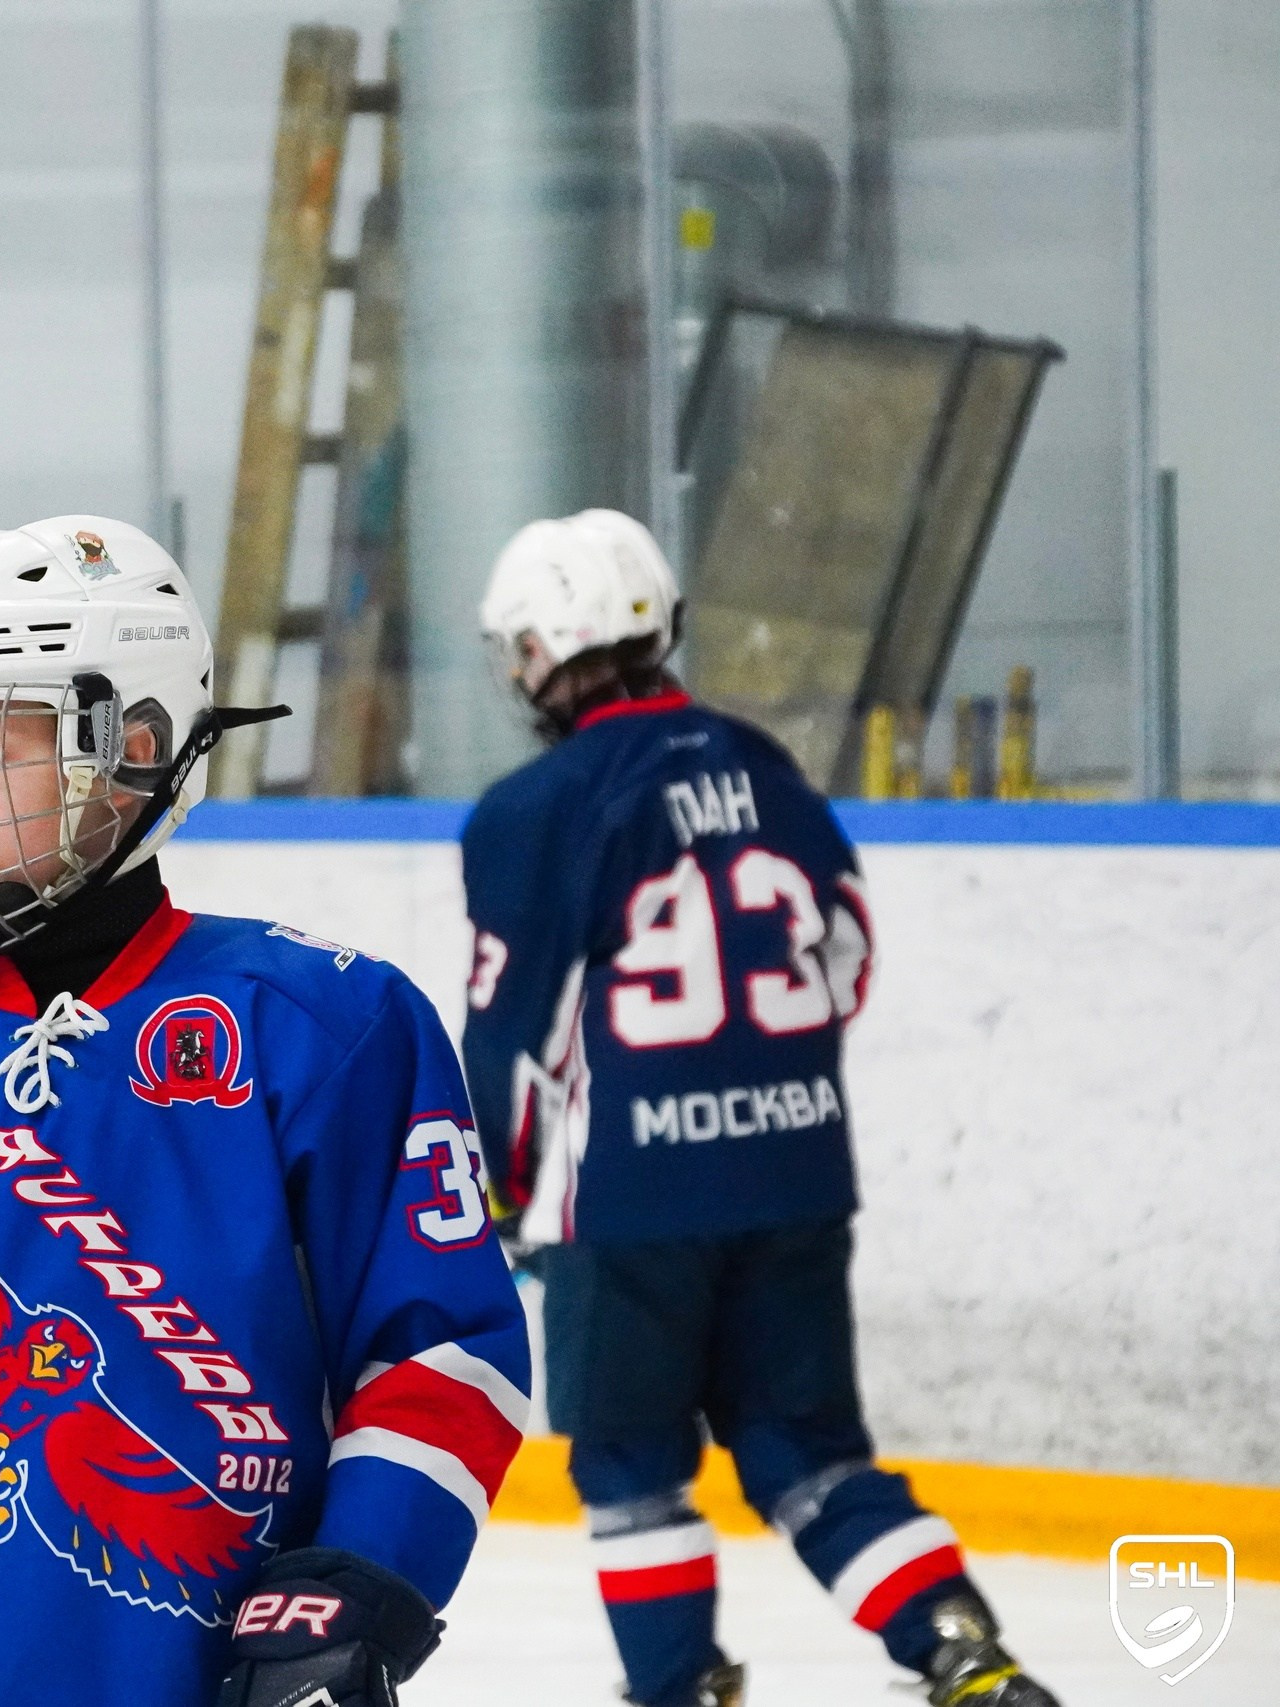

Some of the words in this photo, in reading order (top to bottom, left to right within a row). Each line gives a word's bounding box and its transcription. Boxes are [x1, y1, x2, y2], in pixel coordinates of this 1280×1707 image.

[118, 626, 190, 642] BAUER
[102, 703, 113, 761] BAUER
[610, 846, 833, 1048] 93
[631, 1075, 842, 1147] МОСКВА
[218, 1453, 293, 1494] 2012
[234, 1592, 343, 1640] ER
